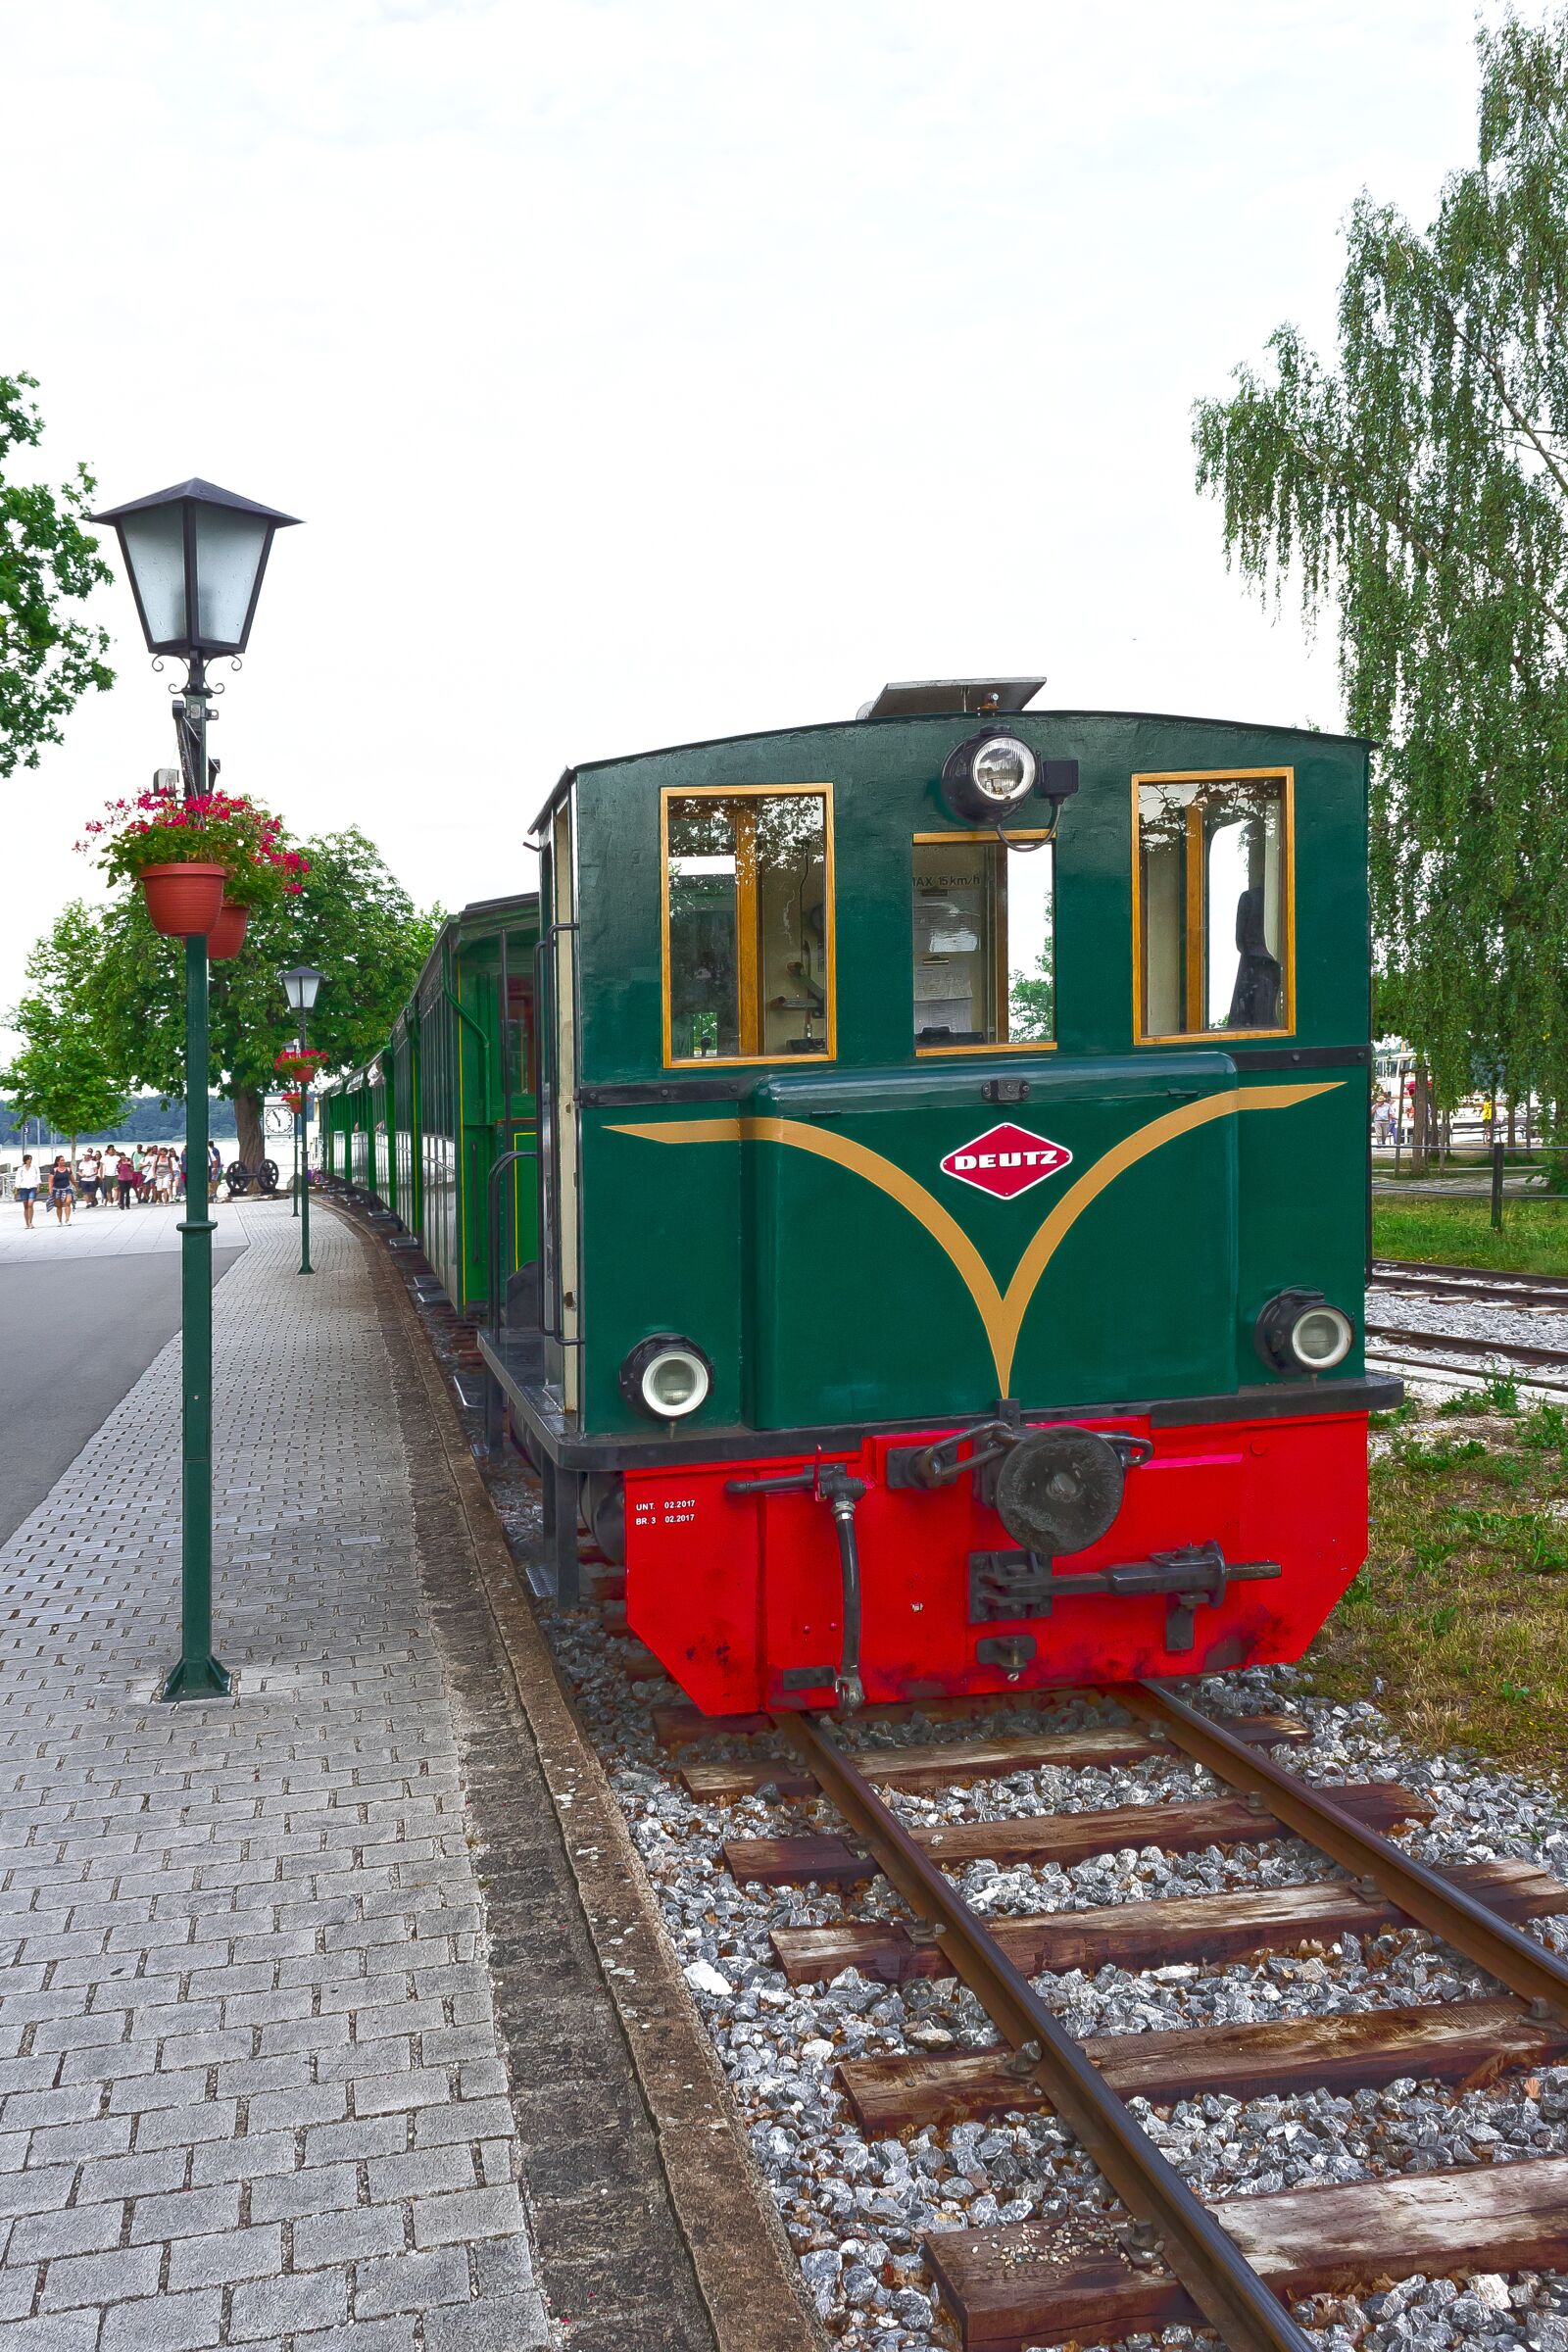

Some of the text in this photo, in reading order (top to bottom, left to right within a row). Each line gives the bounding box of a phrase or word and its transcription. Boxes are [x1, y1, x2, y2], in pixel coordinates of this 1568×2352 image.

[955, 1150, 1057, 1171] DEUTZ
[636, 1499, 696, 1511] UNT. 02.2017
[635, 1517, 650, 1526] BR.
[664, 1513, 695, 1523] 02.2017
